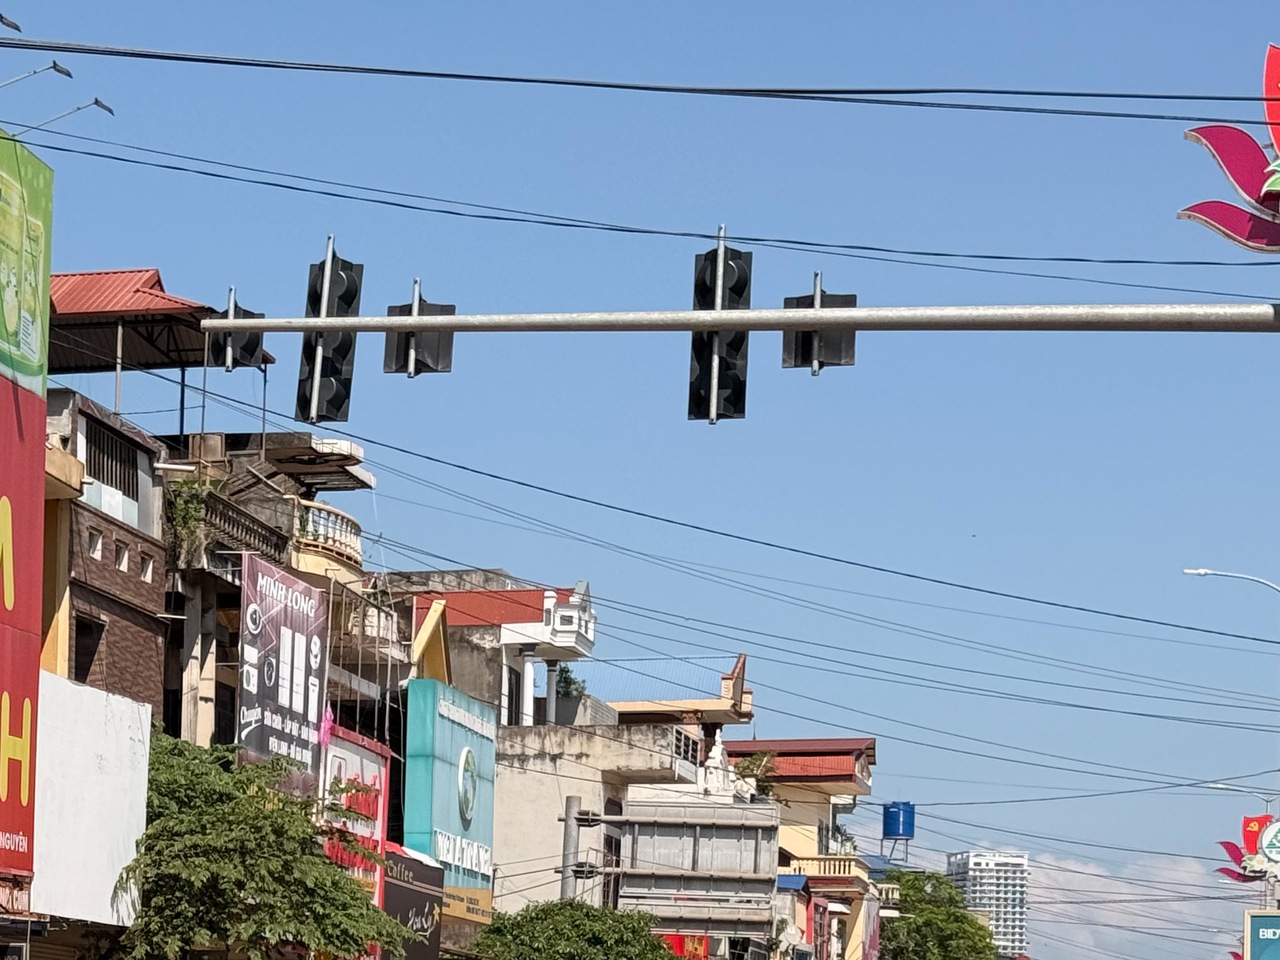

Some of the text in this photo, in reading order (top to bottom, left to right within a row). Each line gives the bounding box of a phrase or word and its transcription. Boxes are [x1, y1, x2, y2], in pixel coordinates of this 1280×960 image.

[257, 572, 316, 618] MINH LONG
[0, 831, 28, 853] NGUYÊN
[387, 860, 414, 883] Coffee
